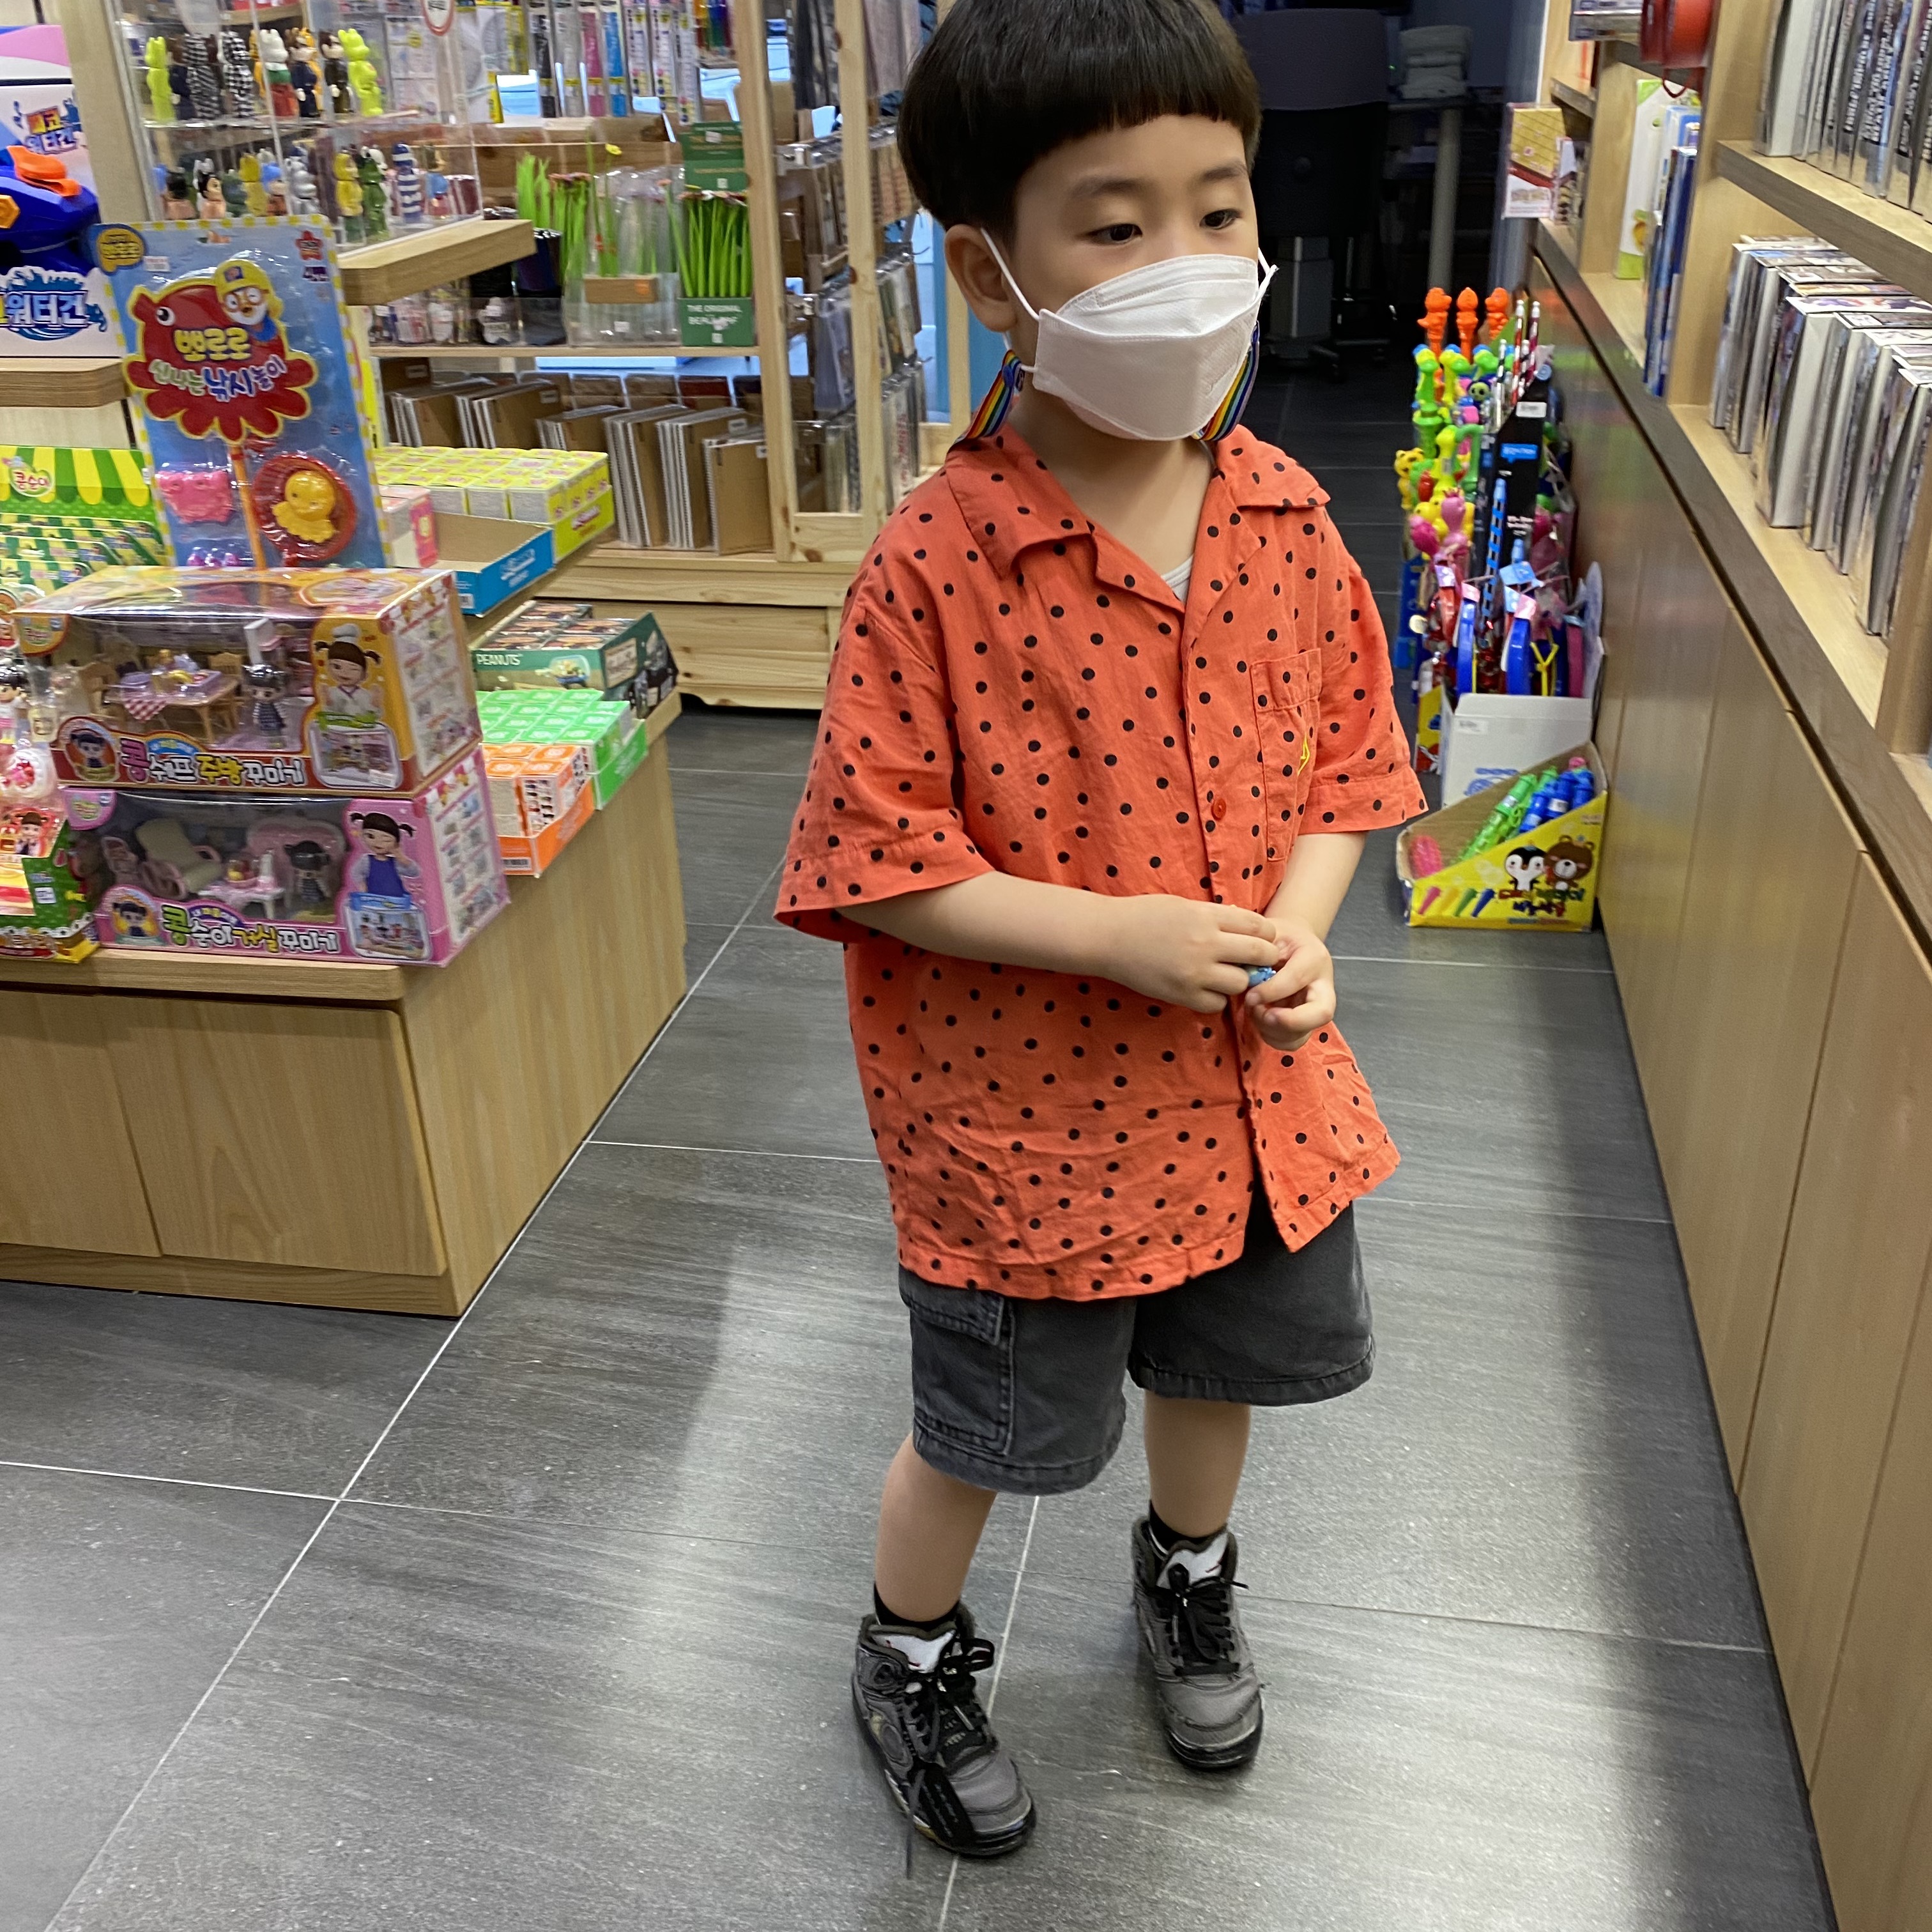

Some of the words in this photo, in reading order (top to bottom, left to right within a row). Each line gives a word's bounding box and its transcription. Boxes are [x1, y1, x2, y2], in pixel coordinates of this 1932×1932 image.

[6, 291, 88, 326] 워터건
[174, 327, 251, 362] 뽀로로
[149, 360, 206, 395] 신나는
[201, 367, 255, 401] 낚시
[249, 354, 288, 391] 놀이
[13, 470, 51, 491] 콩순이
[476, 654, 521, 666] PEANUTS
[195, 753, 244, 786] 주방
[241, 758, 306, 786] 꾸미기
[162, 904, 234, 950] 콩순이
[232, 924, 279, 953] 거실
[277, 928, 339, 953] 꾸미기
